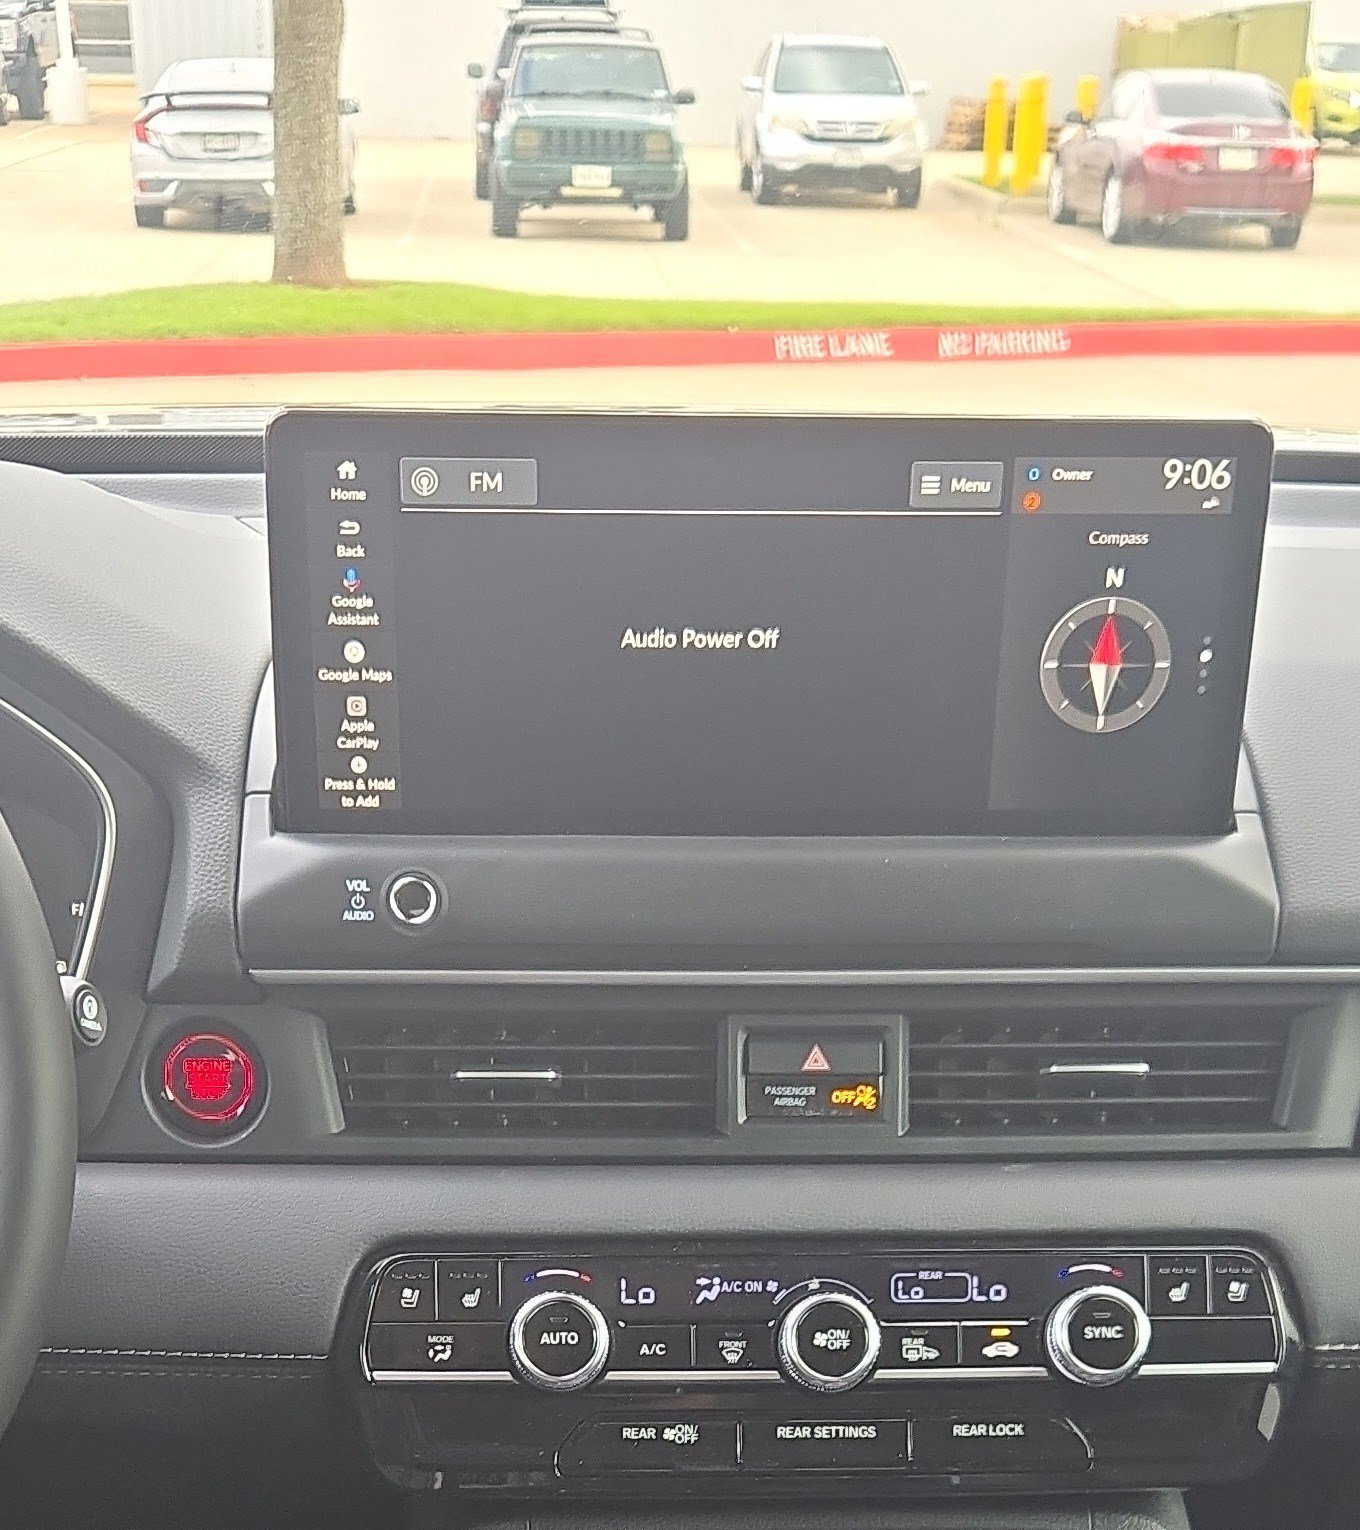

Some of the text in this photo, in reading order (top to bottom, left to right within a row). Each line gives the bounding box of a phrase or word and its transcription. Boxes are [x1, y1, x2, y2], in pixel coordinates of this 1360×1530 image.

[774, 332, 894, 360] FIRE LANE
[975, 329, 1071, 356] PARKING
[1051, 468, 1093, 482] Owner
[1163, 459, 1231, 490] 9:06
[469, 472, 503, 493] FM
[950, 477, 991, 493] Menu
[330, 487, 367, 501] Home
[1089, 531, 1150, 547] Compass
[336, 544, 366, 558] Back
[1105, 567, 1126, 588] N
[331, 594, 374, 609] Google
[327, 612, 380, 626] Assistant
[620, 626, 781, 649] Audio Power Off
[318, 667, 393, 683] Google Maps
[340, 719, 375, 733] Apple
[336, 736, 380, 750] CarPlay
[324, 777, 396, 791] Press & Hold
[341, 794, 380, 808] to Add
[345, 879, 371, 892] VOL
[342, 910, 375, 921] AUDIO
[184, 1060, 231, 1072] ENGINE
[764, 1086, 817, 1097] PASSENGER
[831, 1089, 857, 1104] OFF
[918, 1271, 943, 1280] REAR
[620, 1277, 656, 1304] Lo
[721, 1281, 763, 1294] A/C ON
[972, 1275, 1008, 1301] Lo
[427, 1334, 455, 1344] MODE
[540, 1332, 579, 1345] AUTO
[828, 1329, 851, 1340] ON/
[1083, 1325, 1125, 1340] SYNC
[718, 1340, 747, 1349] FRONT
[828, 1340, 851, 1350] OFF
[902, 1337, 925, 1346] REAR
[639, 1343, 667, 1356] A/C
[622, 1427, 657, 1440] REAR
[776, 1425, 878, 1439] REAR SETTINGS
[952, 1423, 1025, 1437] REAR LOCK
[675, 1433, 699, 1445] OFF
